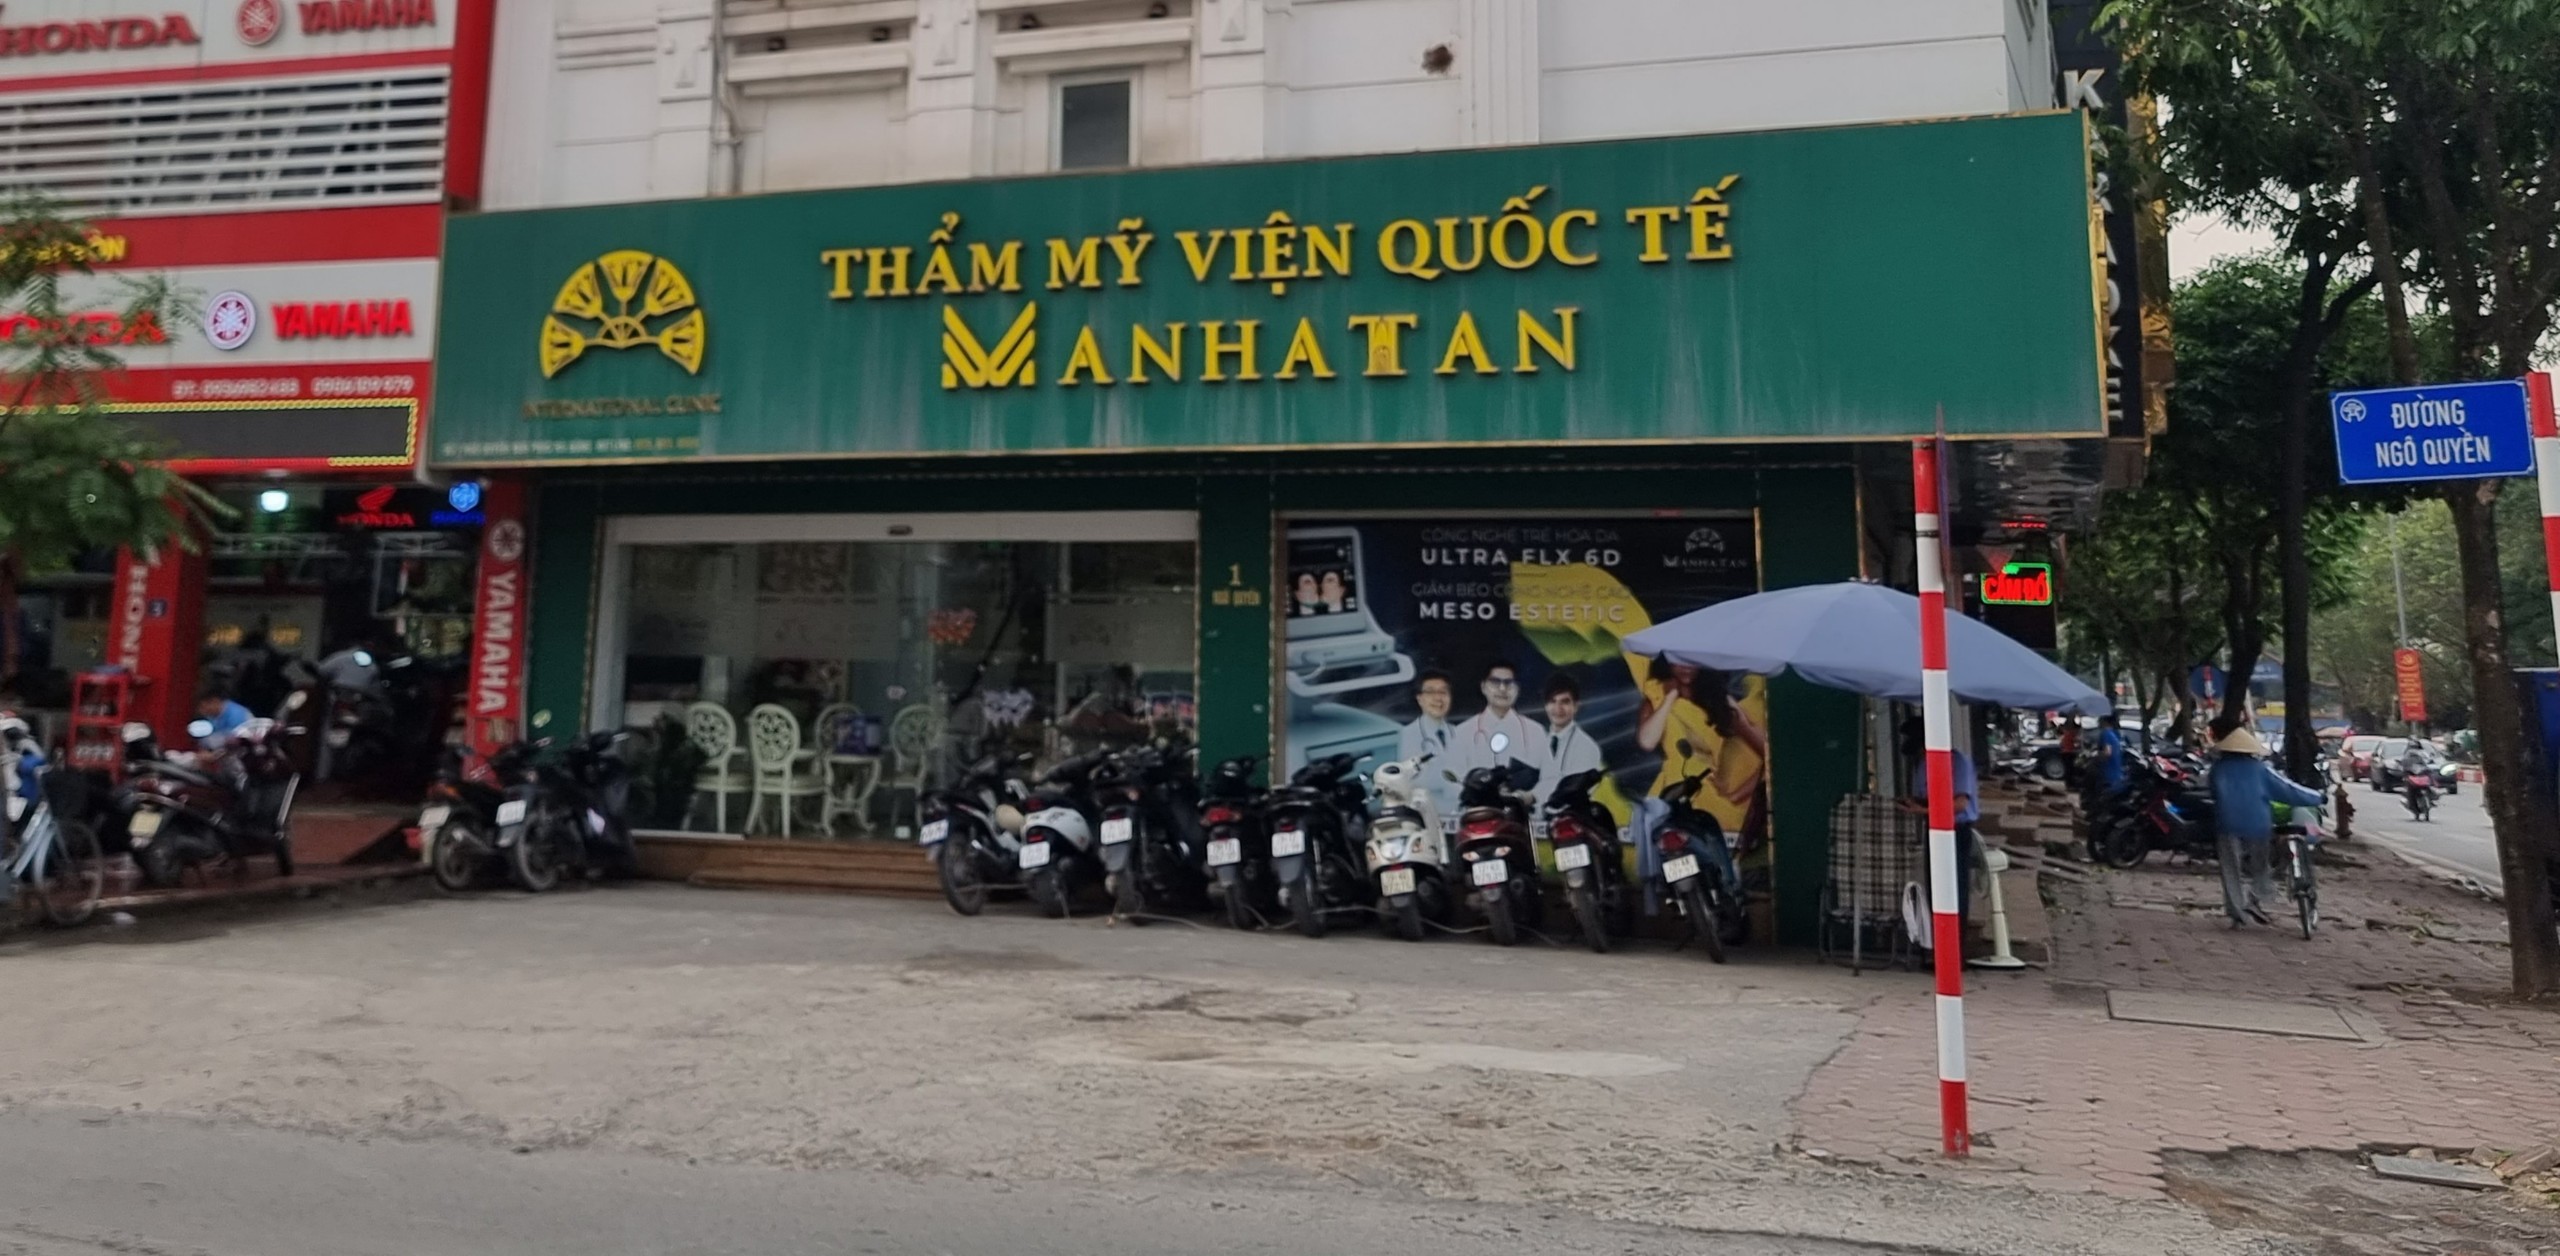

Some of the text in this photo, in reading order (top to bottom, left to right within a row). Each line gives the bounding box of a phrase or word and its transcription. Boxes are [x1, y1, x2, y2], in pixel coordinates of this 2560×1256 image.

[0, 14, 201, 56] HONDA
[299, 0, 437, 36] YAMAHA
[821, 174, 1740, 298] THẨM MỸ VIỆN QUỐC TẾ
[271, 300, 414, 340] YAMAHA
[2391, 393, 2466, 429] ĐƯỜNG
[2375, 427, 2492, 468] NGÔ QUYỀN
[1228, 563, 1241, 587] 1
[1421, 548, 1508, 565] ULTRA
[1585, 549, 1622, 566] 6D
[1419, 602, 1625, 622] MESO ESTETIC
[476, 571, 517, 713] YAMAHA
